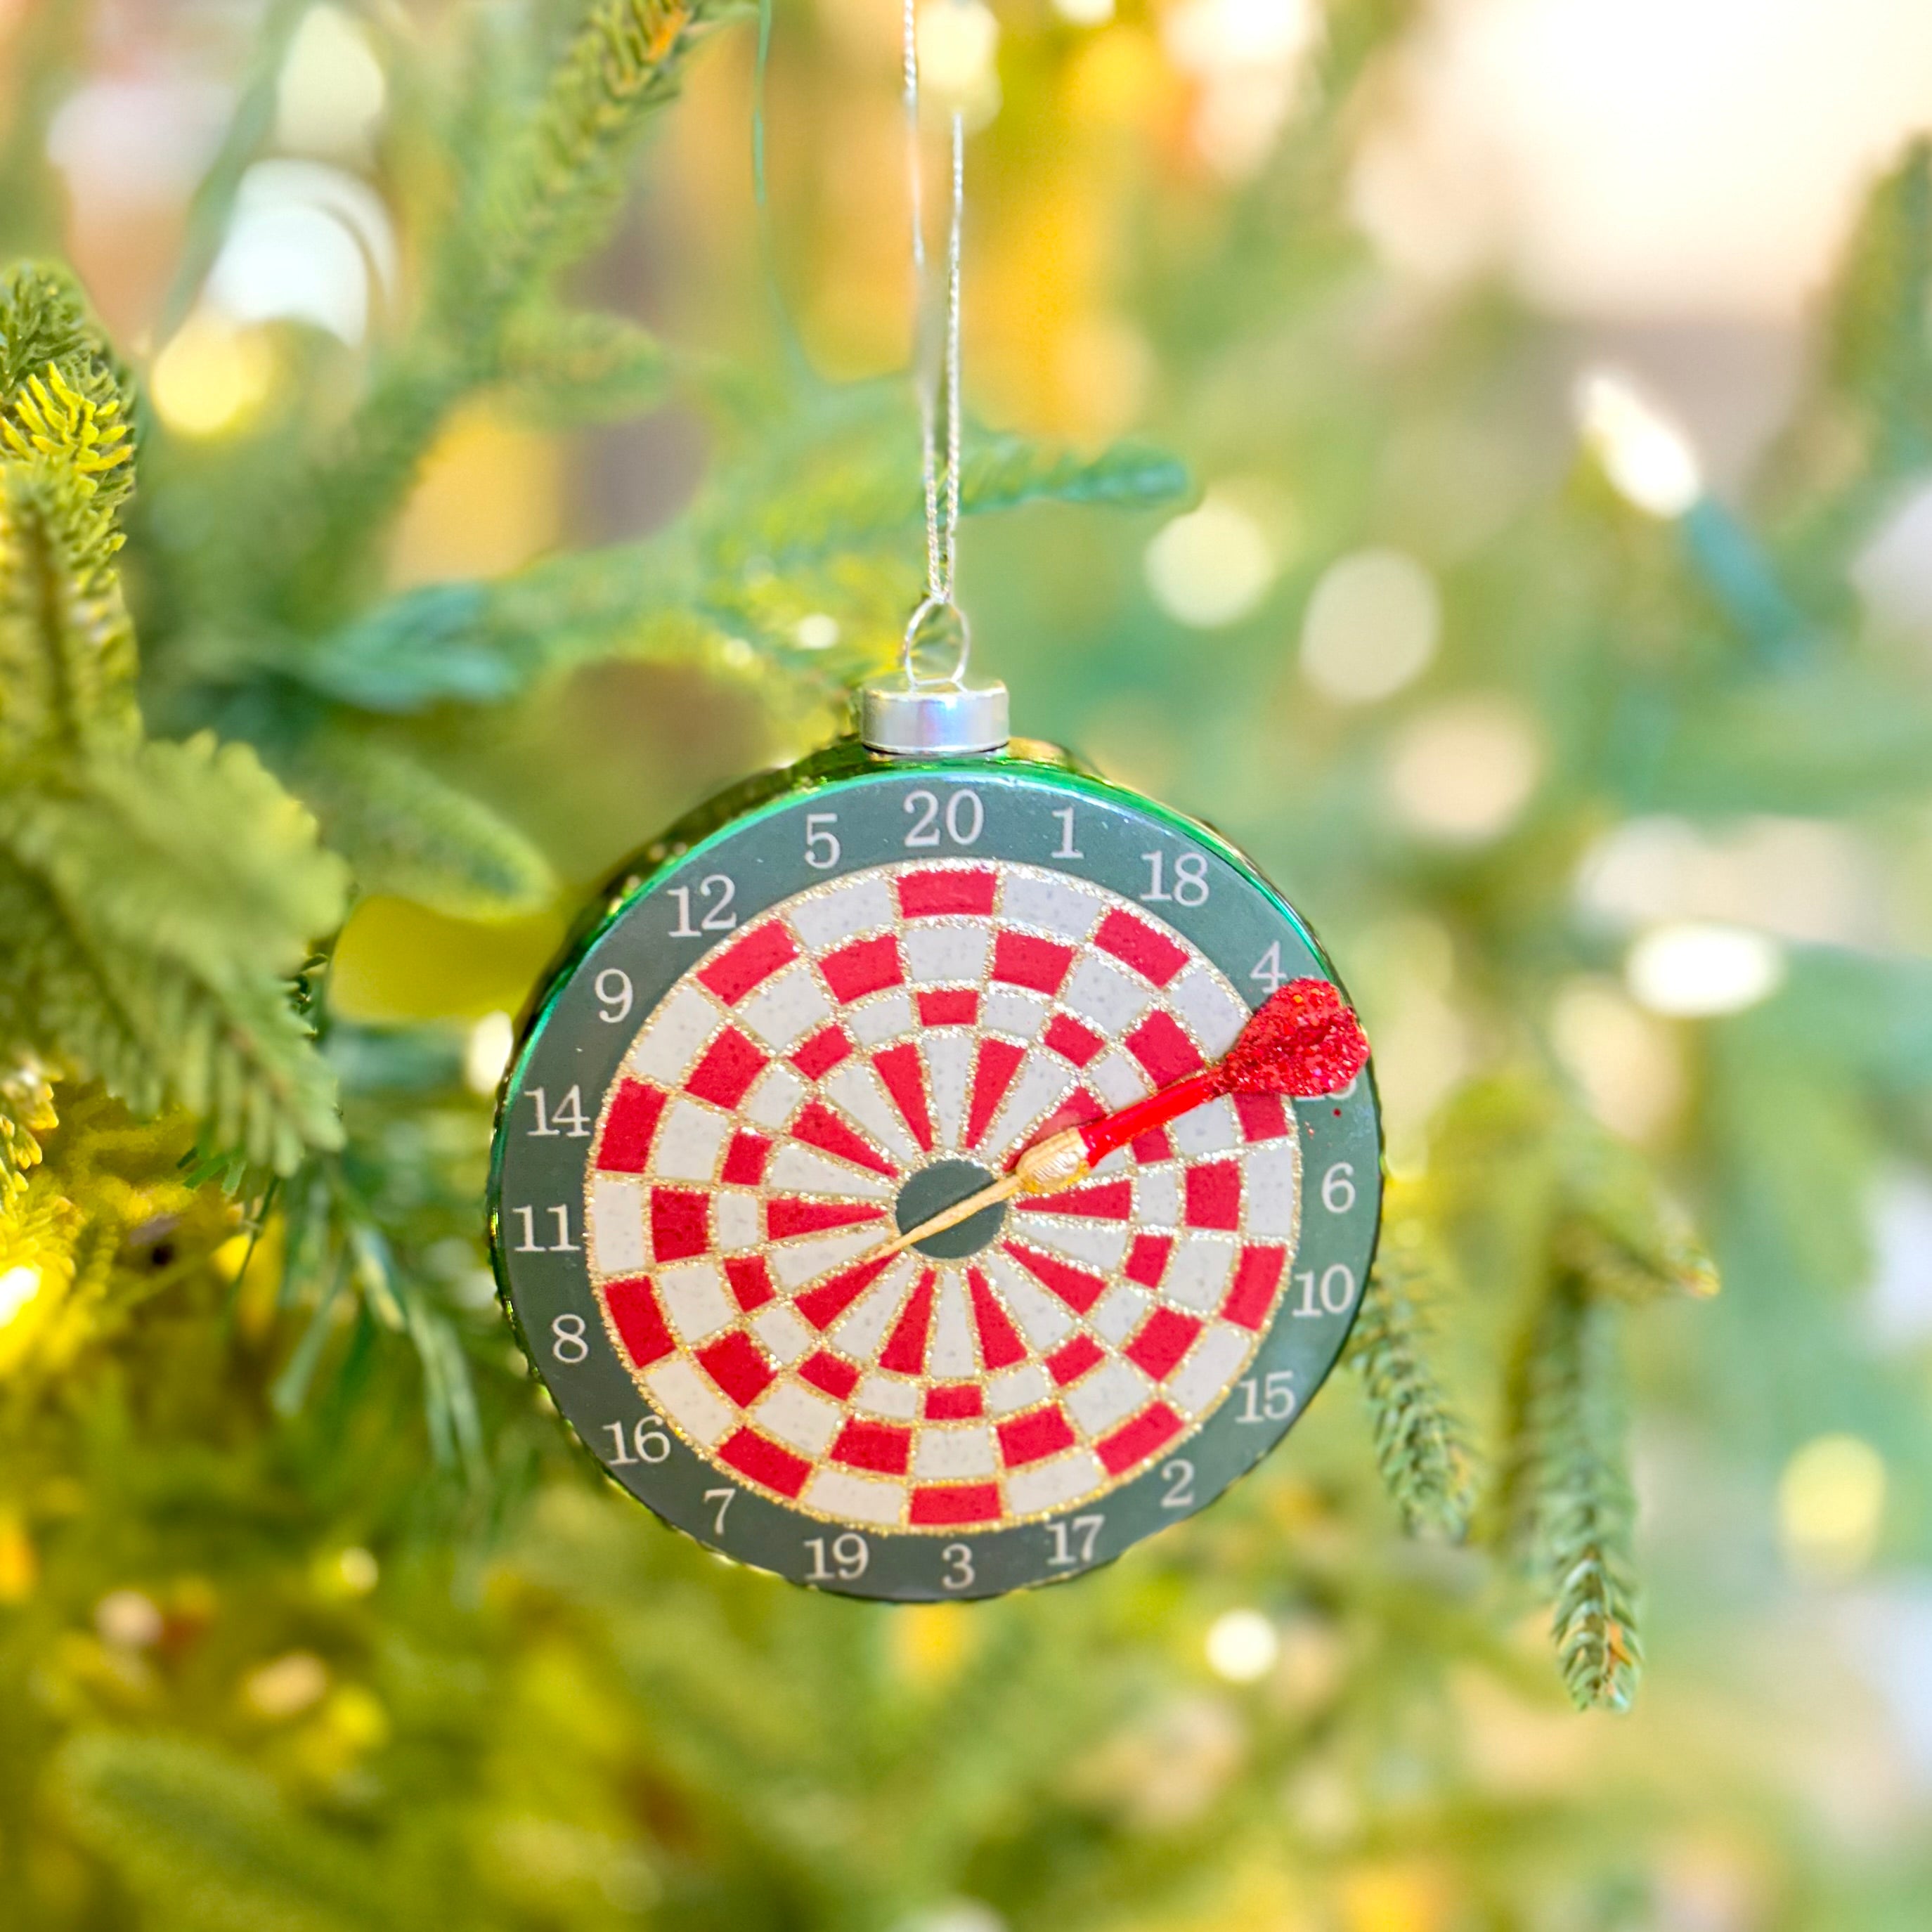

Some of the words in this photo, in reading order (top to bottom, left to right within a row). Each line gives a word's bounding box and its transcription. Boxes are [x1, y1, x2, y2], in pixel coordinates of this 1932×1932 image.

[803, 813, 841, 869] 5
[904, 789, 984, 847] 20
[1051, 806, 1084, 860] 1
[1140, 850, 1210, 907] 18
[668, 874, 737, 938] 12
[1250, 940, 1287, 994] 4
[594, 968, 633, 1023] 9
[524, 1084, 590, 1137] 14
[1321, 1162, 1355, 1213] 6
[512, 1204, 581, 1252] 11
[1292, 1264, 1354, 1318] 10
[551, 1314, 589, 1363] 8
[1235, 1371, 1295, 1424] 15
[602, 1415, 670, 1465] 16
[1161, 1460, 1194, 1508] 2
[704, 1488, 736, 1535] 7
[803, 1533, 869, 1580] 19
[942, 1543, 975, 1590] 3
[1045, 1515, 1106, 1565] 17
